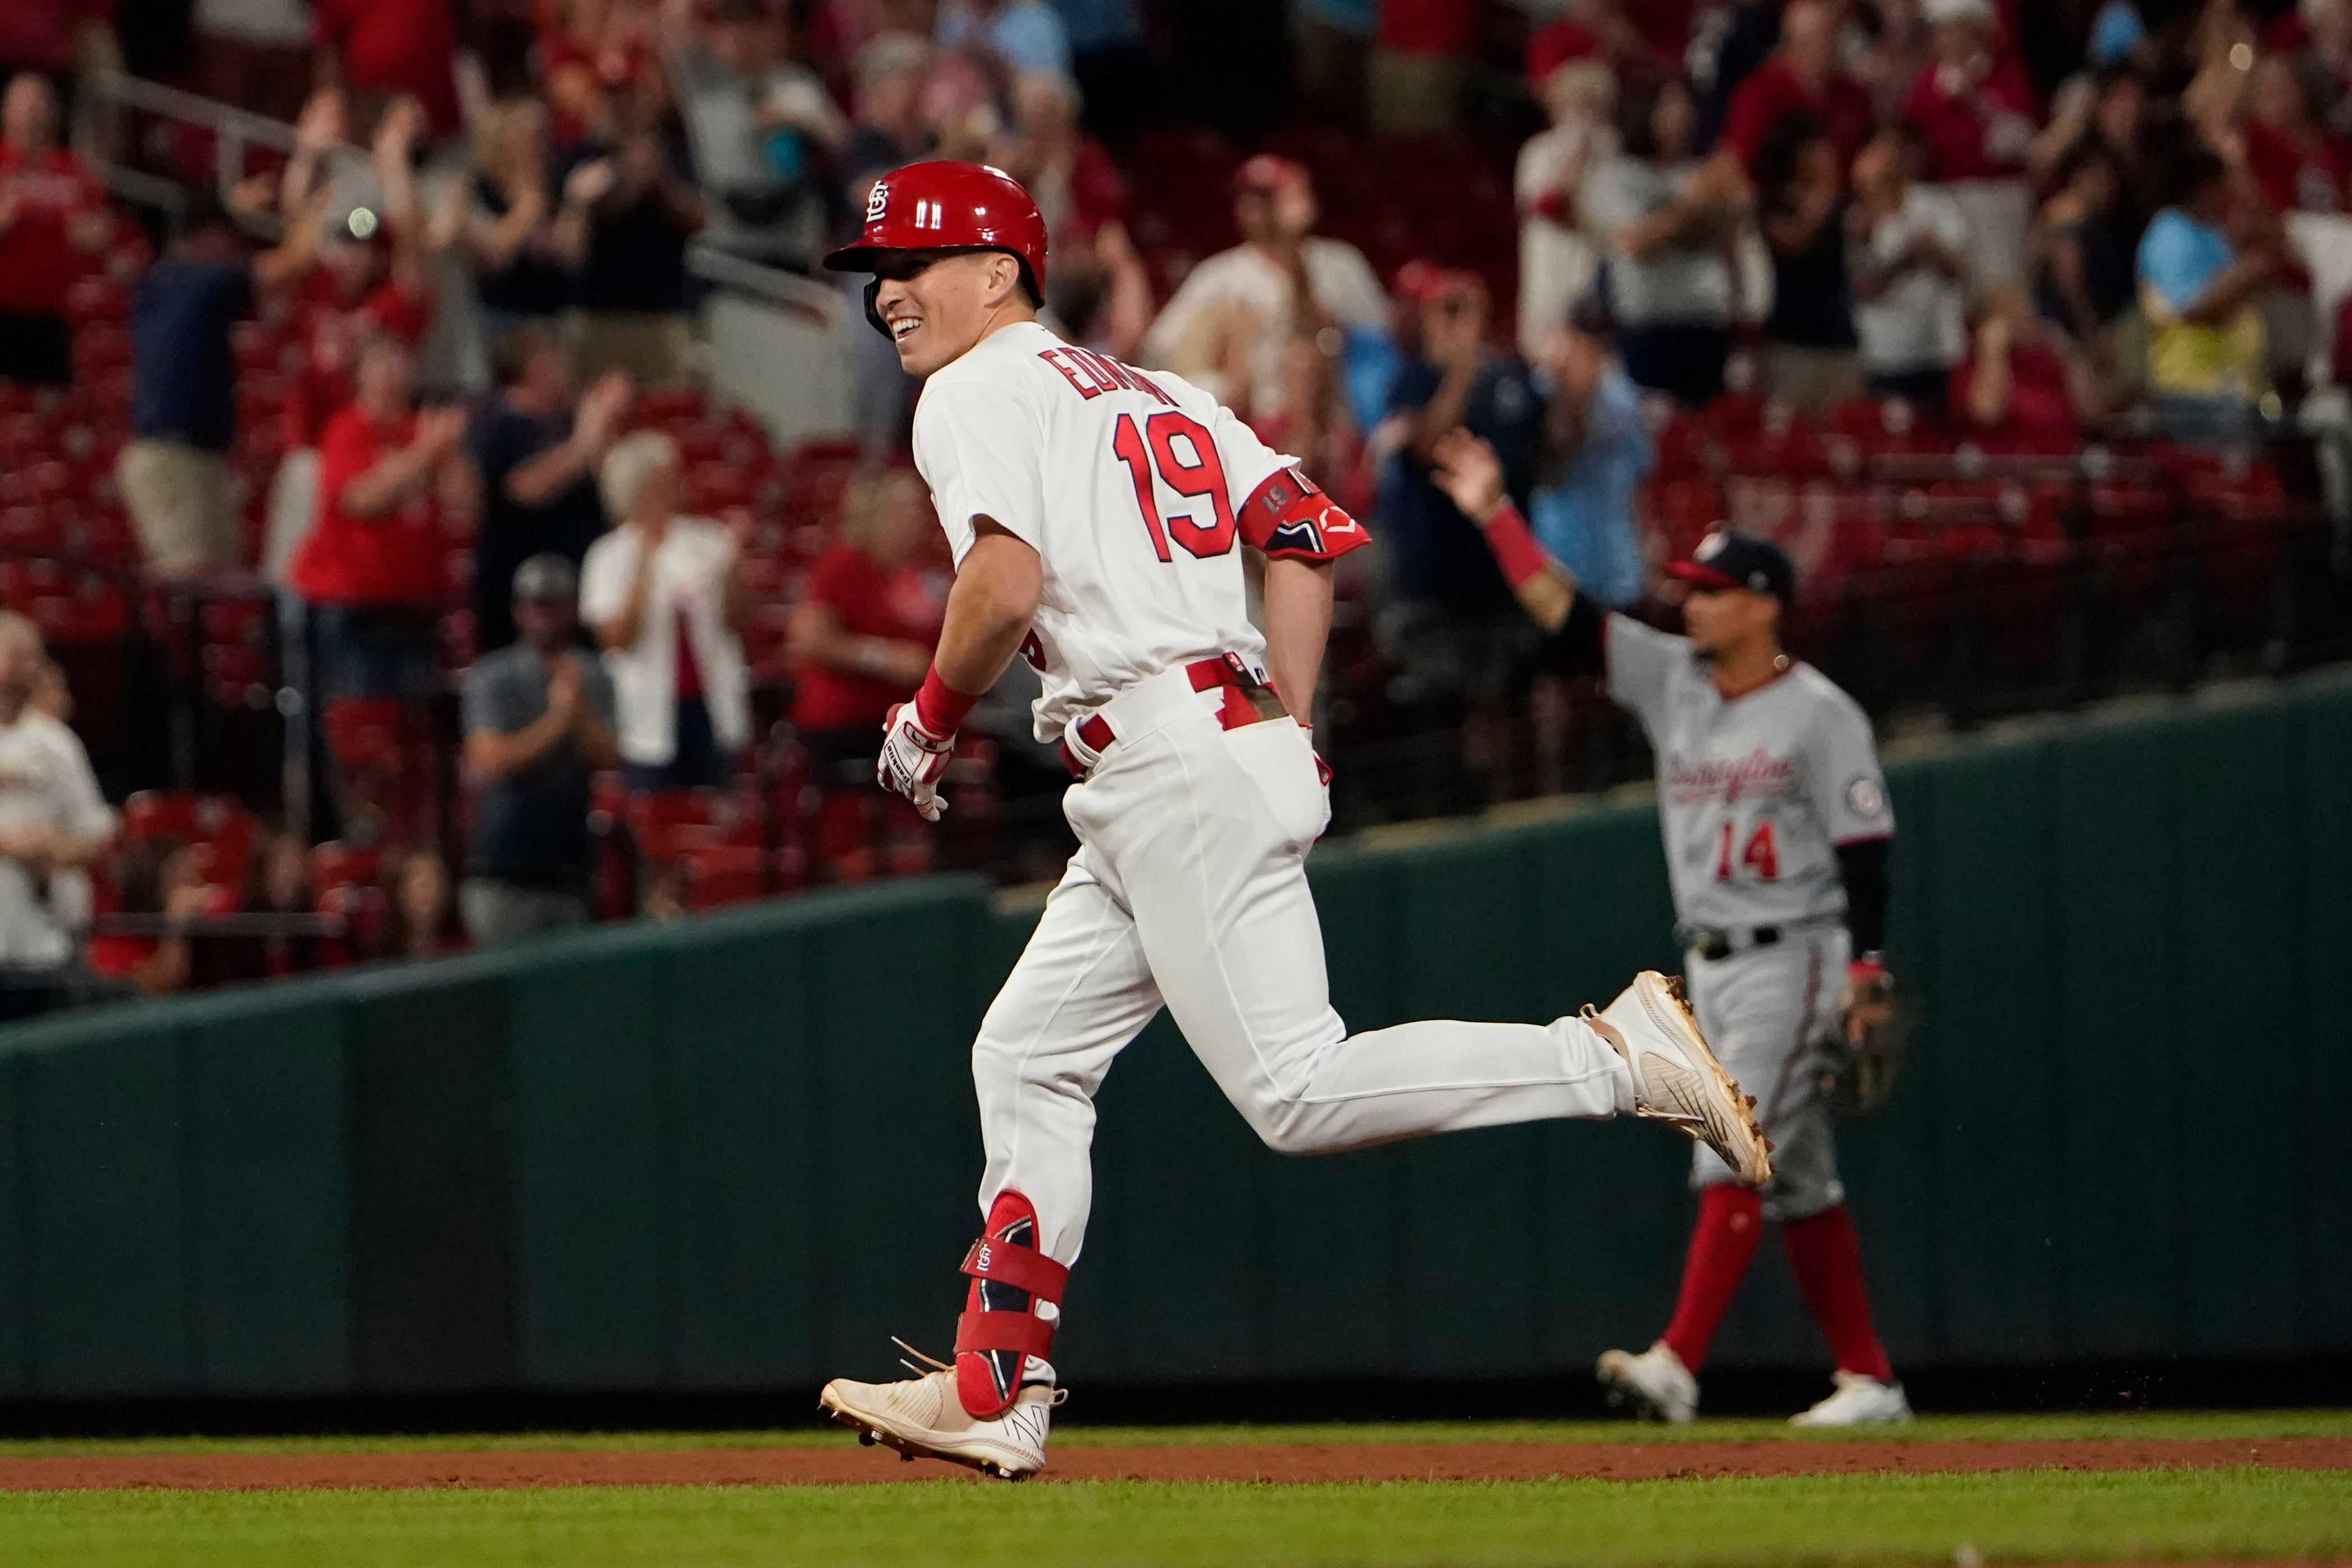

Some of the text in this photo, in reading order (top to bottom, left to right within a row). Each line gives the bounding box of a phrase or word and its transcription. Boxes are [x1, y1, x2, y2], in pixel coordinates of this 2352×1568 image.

[1113, 411, 1237, 563] 19
[1261, 485, 1289, 516] 19
[1715, 818, 1779, 882] 14
